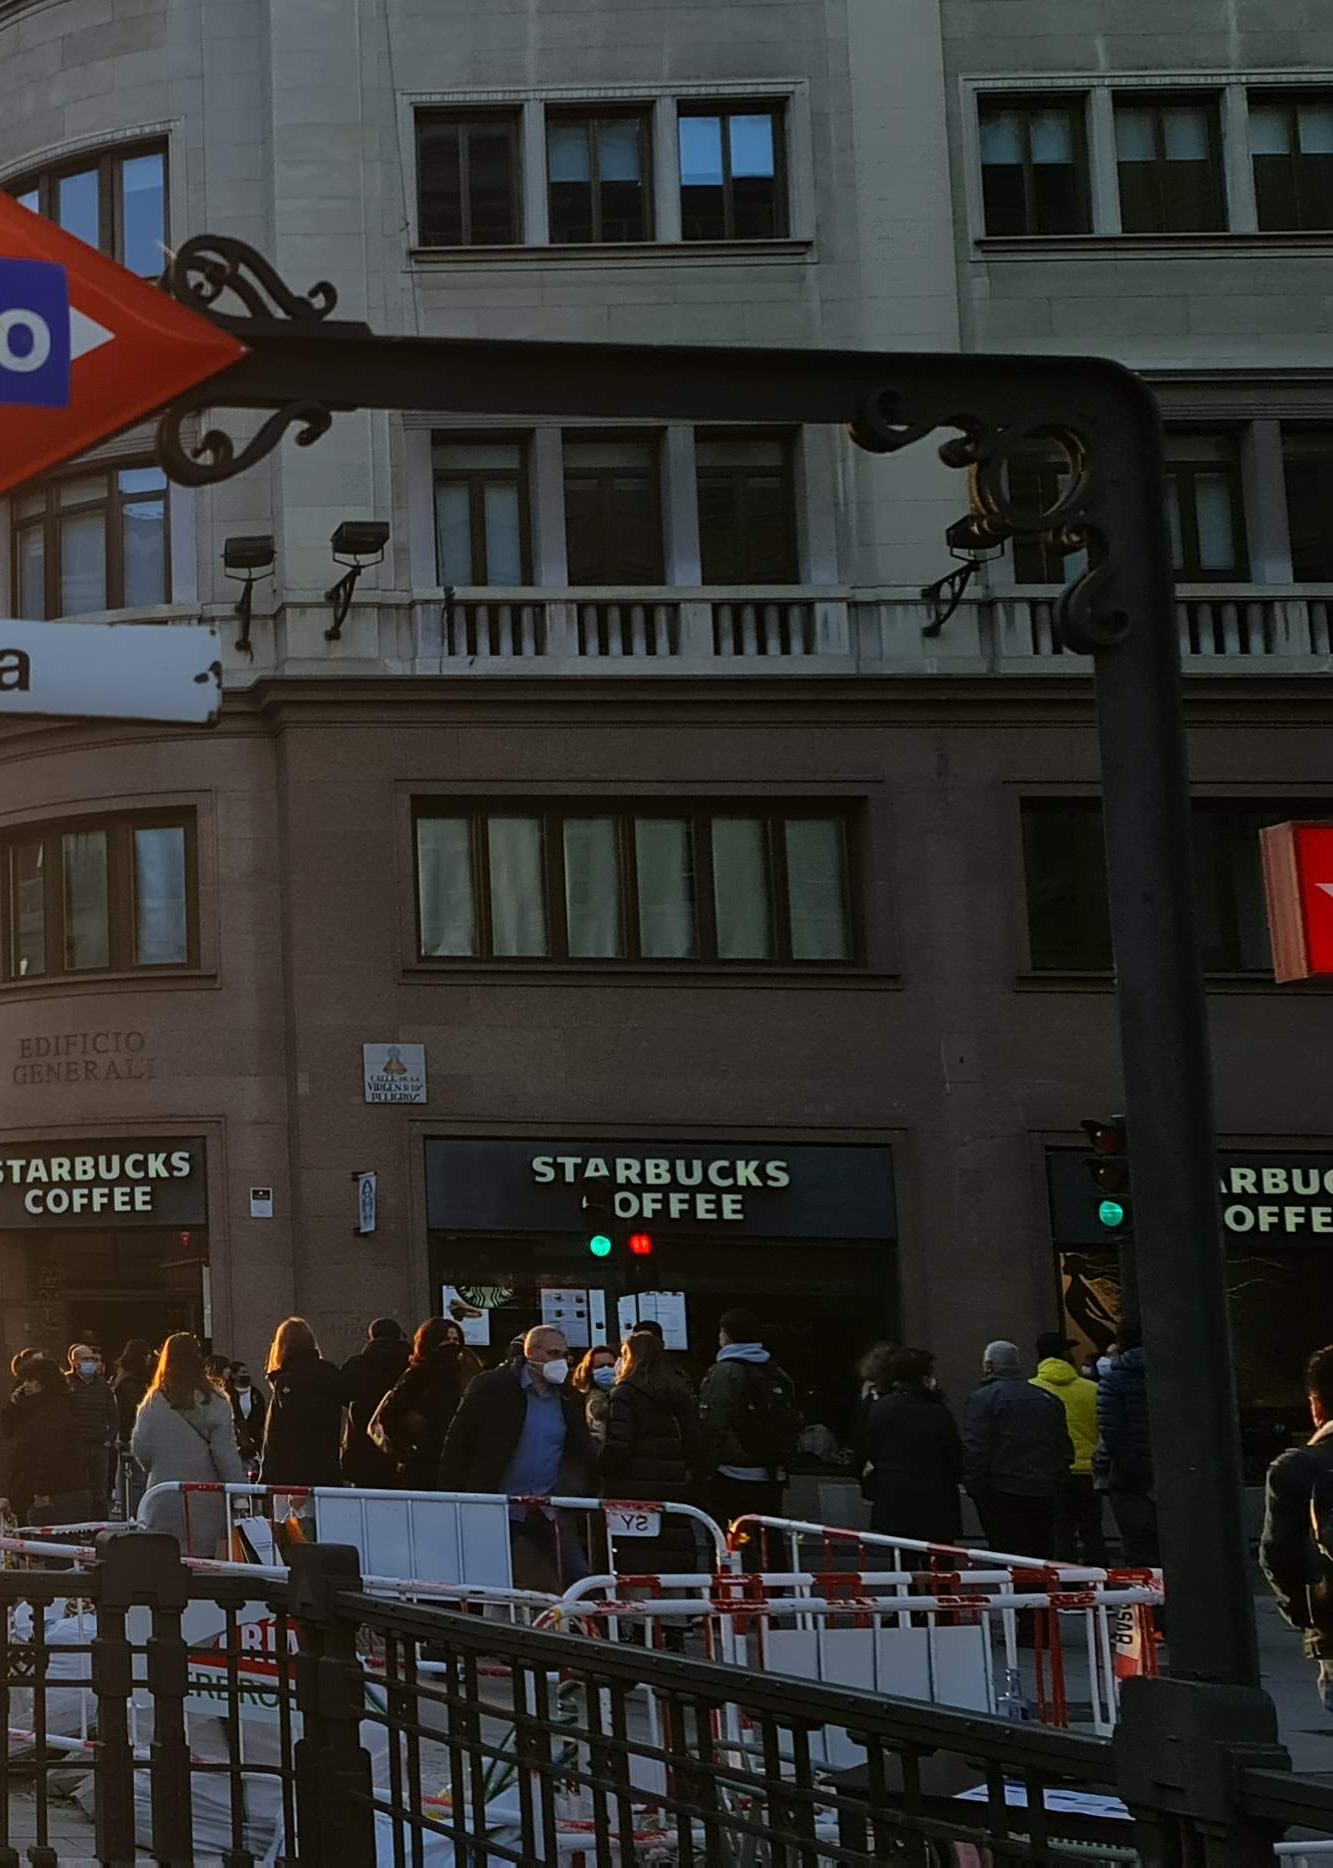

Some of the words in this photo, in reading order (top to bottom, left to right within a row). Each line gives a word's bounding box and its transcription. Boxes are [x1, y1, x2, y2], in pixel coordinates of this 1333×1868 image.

[20, 1031, 146, 1059] EDIFICIO
[12, 1058, 158, 1085] GENERALI
[532, 1156, 790, 1188] STARBUCKS
[1220, 1167, 1333, 1195] RBU
[24, 1186, 152, 1214] COFFEE
[583, 1191, 745, 1220] OFFEE
